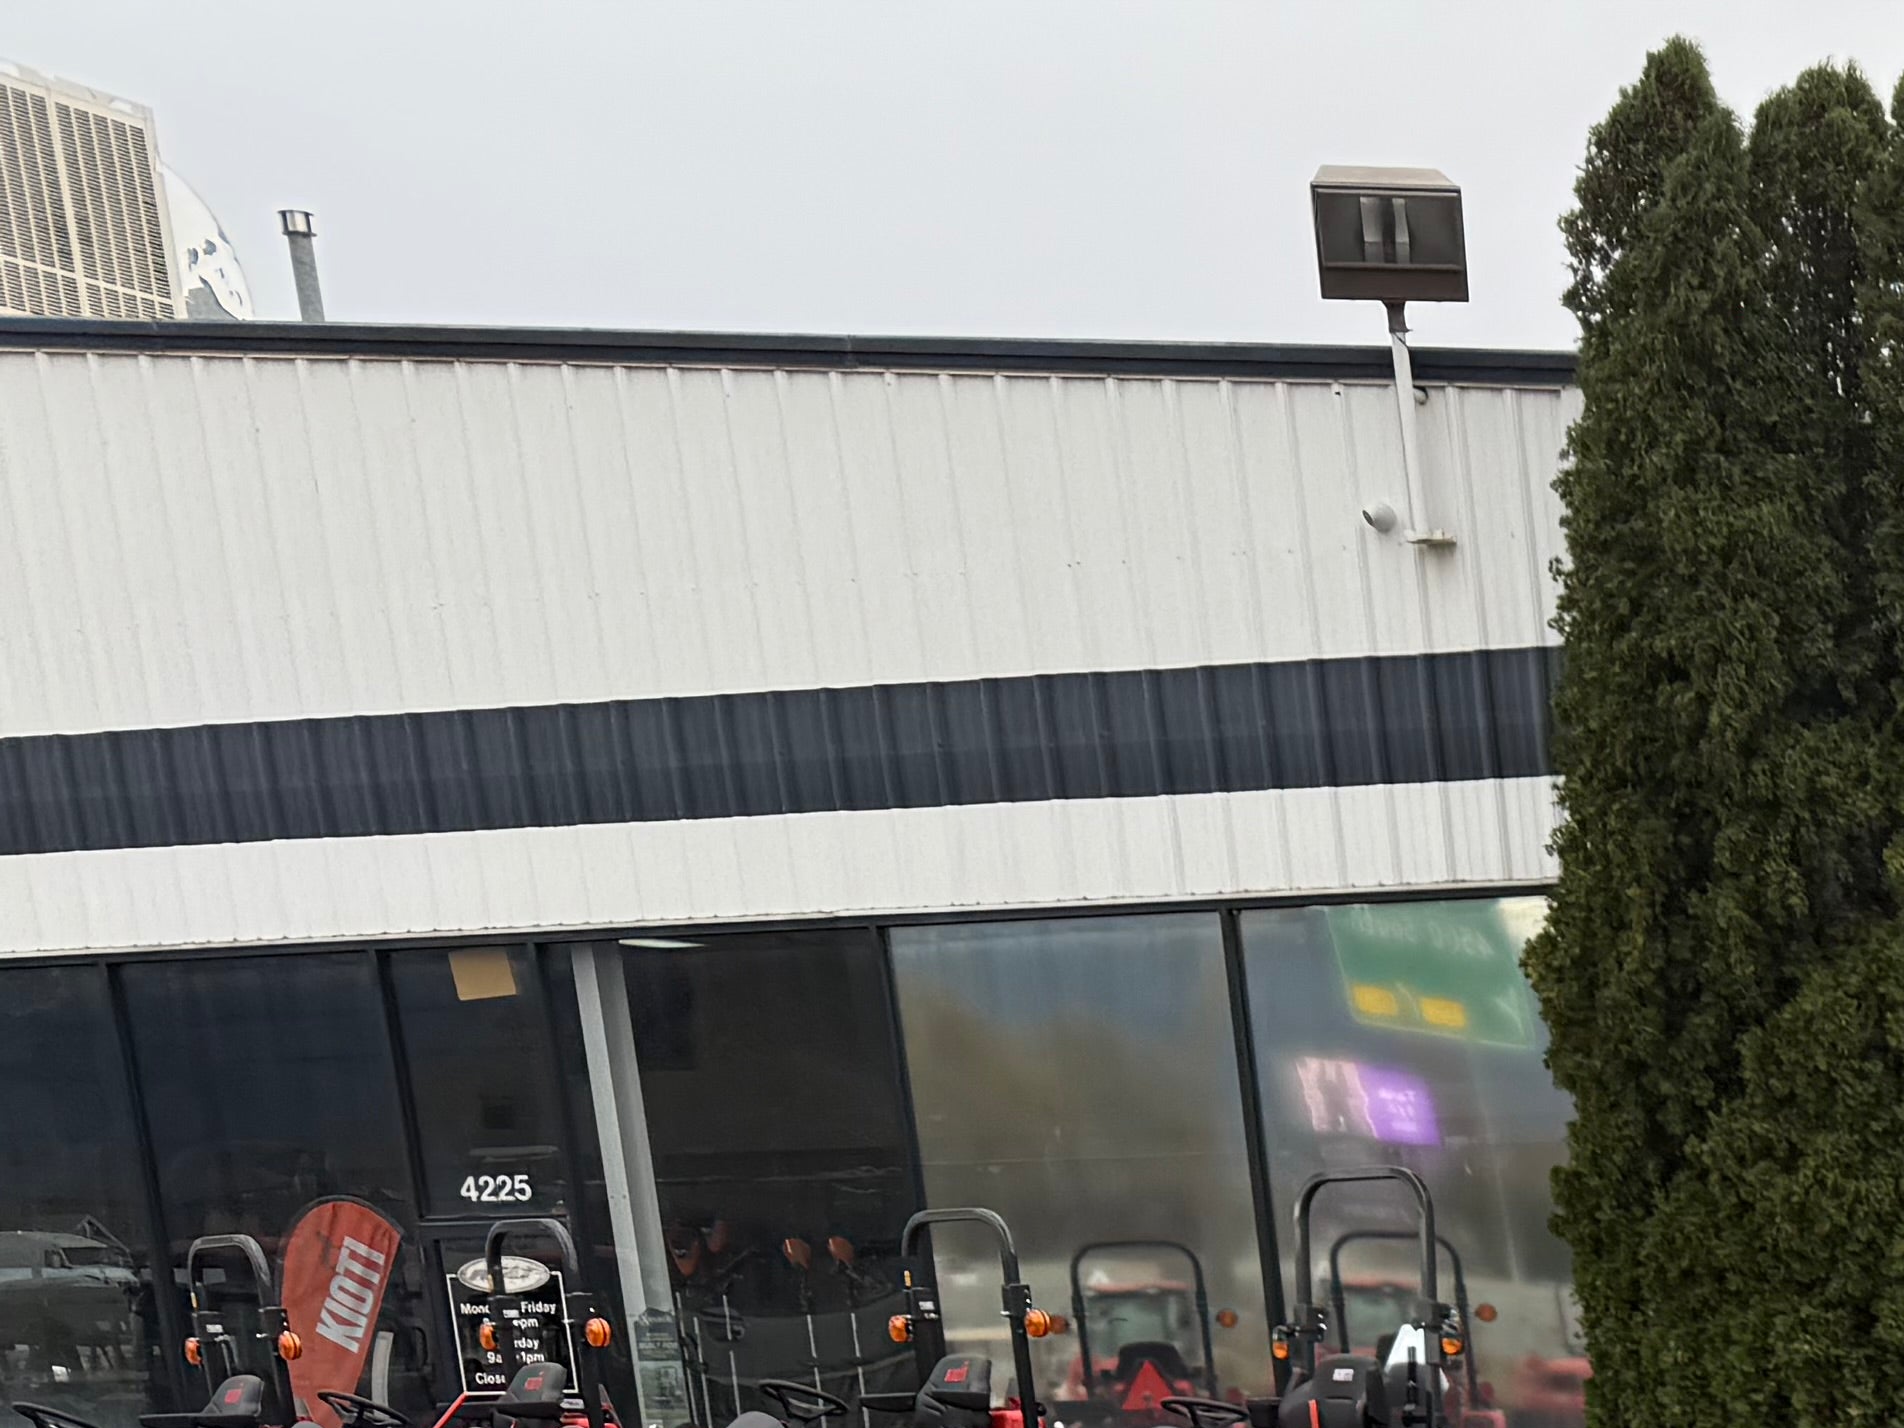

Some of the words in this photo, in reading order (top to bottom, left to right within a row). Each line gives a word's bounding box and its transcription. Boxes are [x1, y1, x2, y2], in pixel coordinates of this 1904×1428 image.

[460, 1174, 532, 1202] 4225
[315, 1235, 385, 1354] KIOTI
[521, 1300, 557, 1315] Friday
[475, 1372, 506, 1385] Clos
